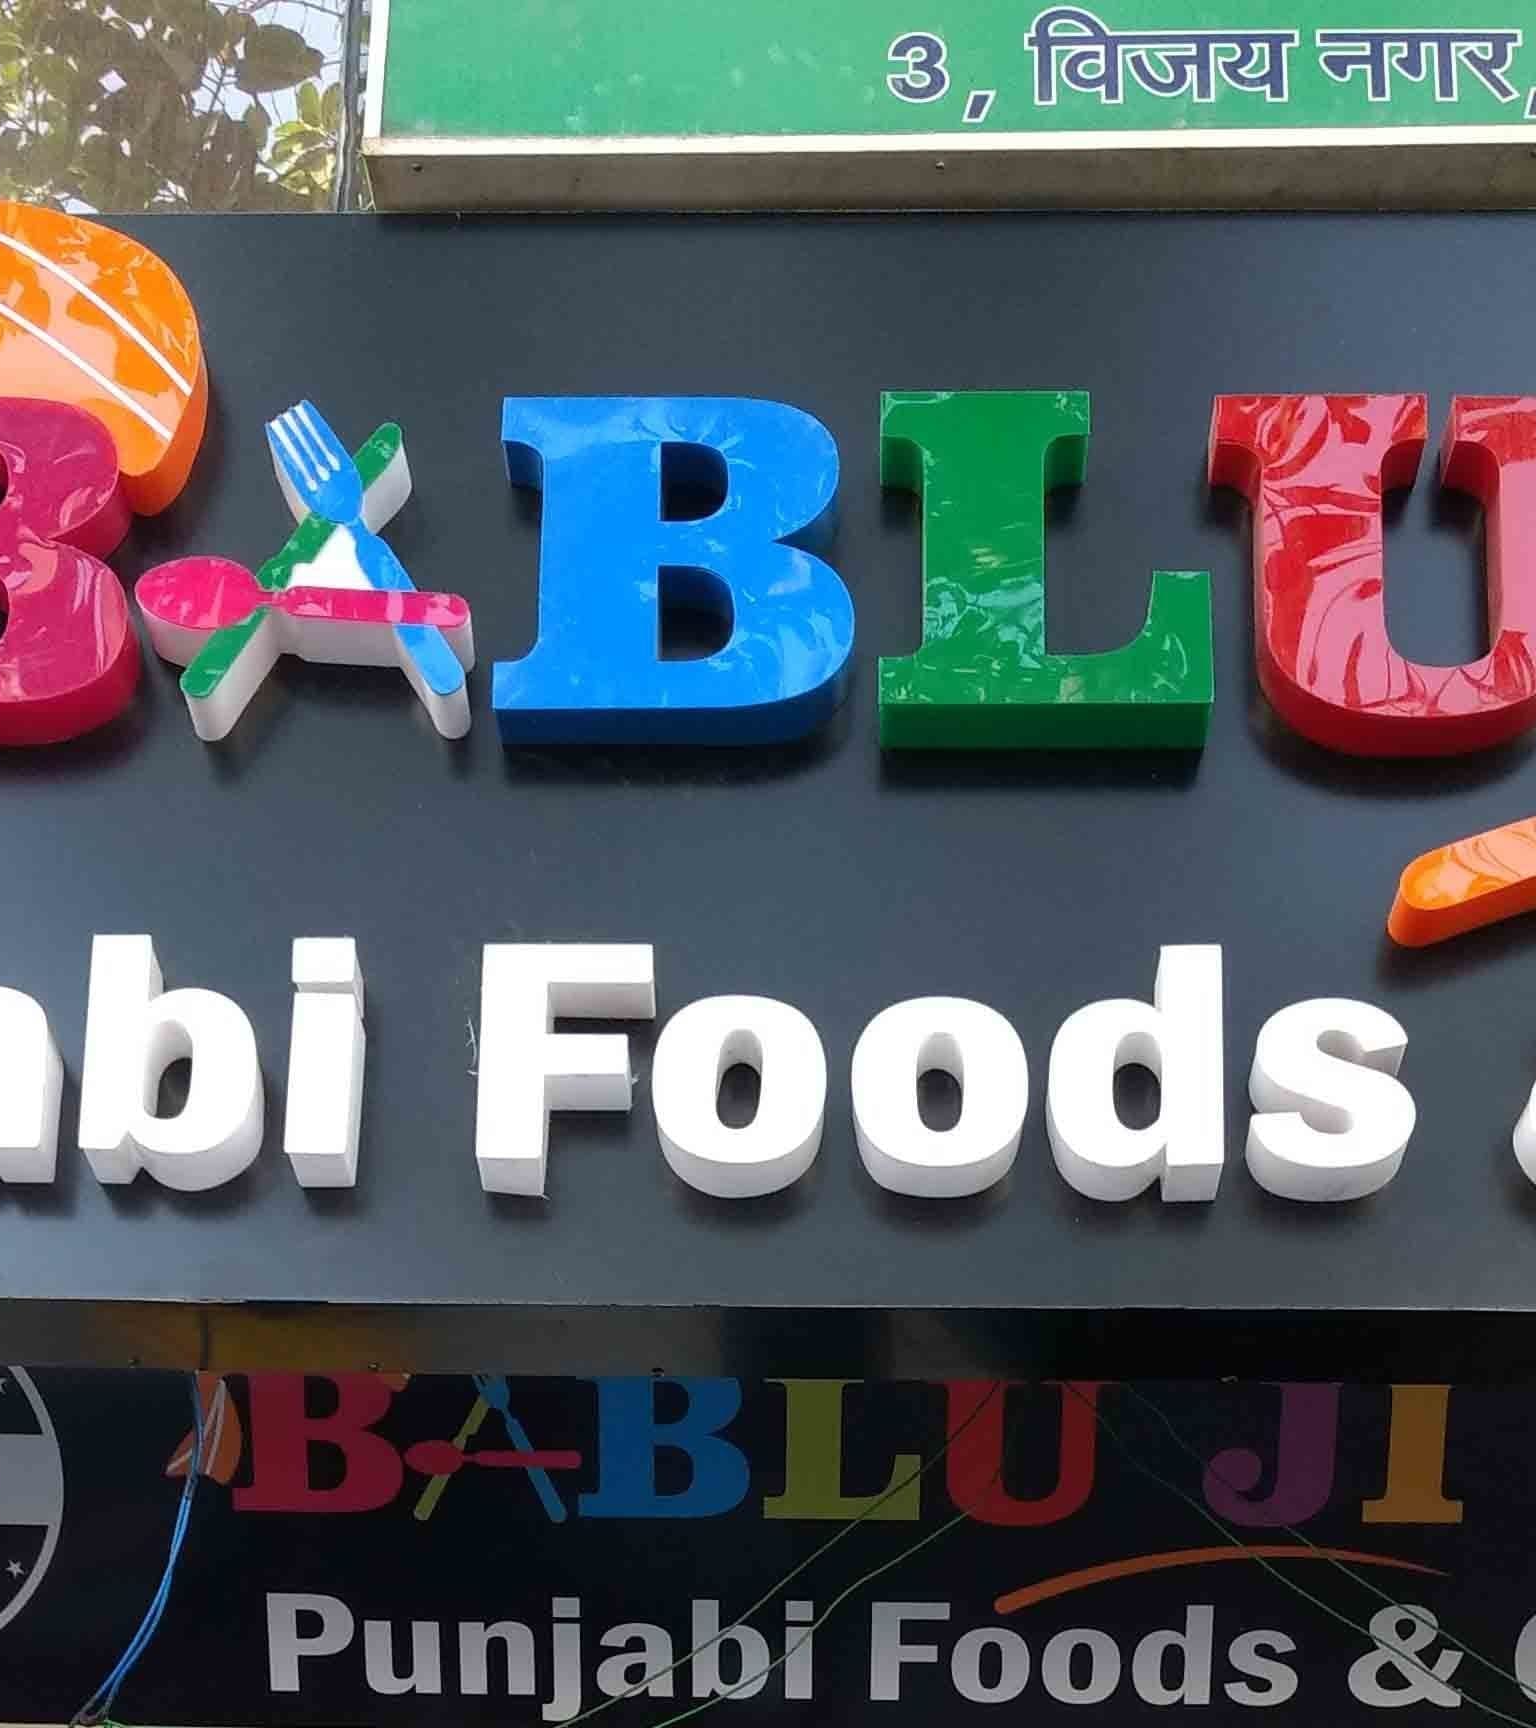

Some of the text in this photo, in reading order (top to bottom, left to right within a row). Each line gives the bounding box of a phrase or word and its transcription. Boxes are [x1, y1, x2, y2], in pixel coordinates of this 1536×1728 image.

[1024, 6, 1300, 107] विजय
[474, 942, 1419, 1208] Foods
[231, 1372, 1465, 1528] BABLU JI
[264, 1590, 814, 1723] Punjabi
[869, 1600, 1301, 1711] Foods
[1346, 1602, 1465, 1711] &
